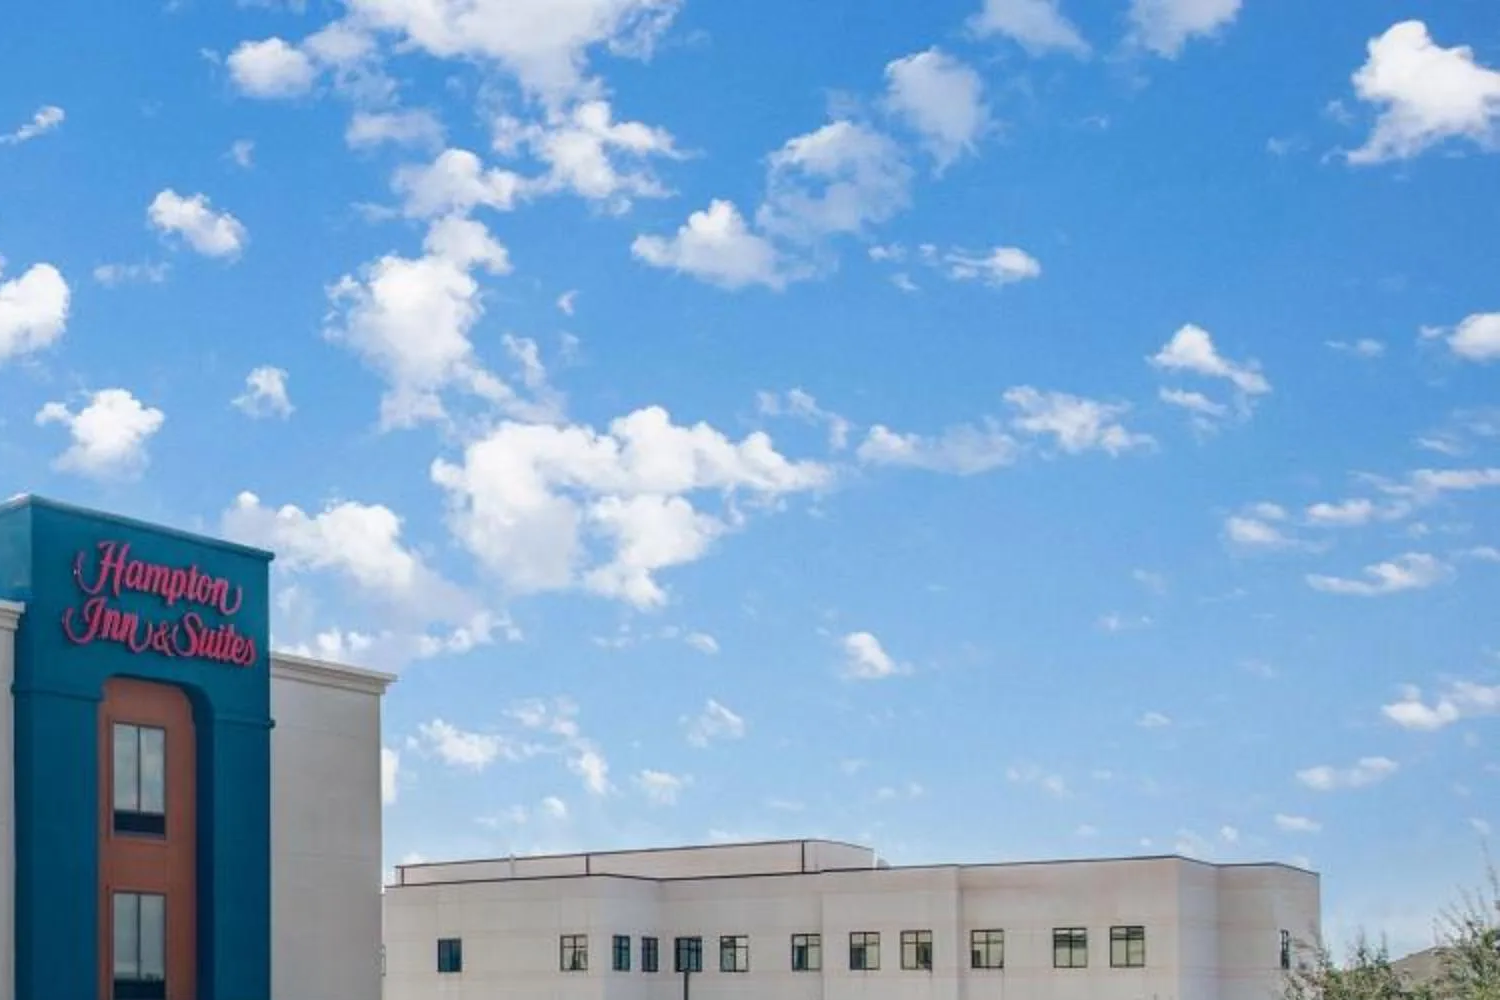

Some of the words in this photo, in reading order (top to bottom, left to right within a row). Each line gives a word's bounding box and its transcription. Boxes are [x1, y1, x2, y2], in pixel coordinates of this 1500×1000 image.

[73, 540, 242, 616] Hampton
[62, 596, 153, 653] Inn
[152, 620, 175, 657] &
[171, 611, 258, 667] Suites
